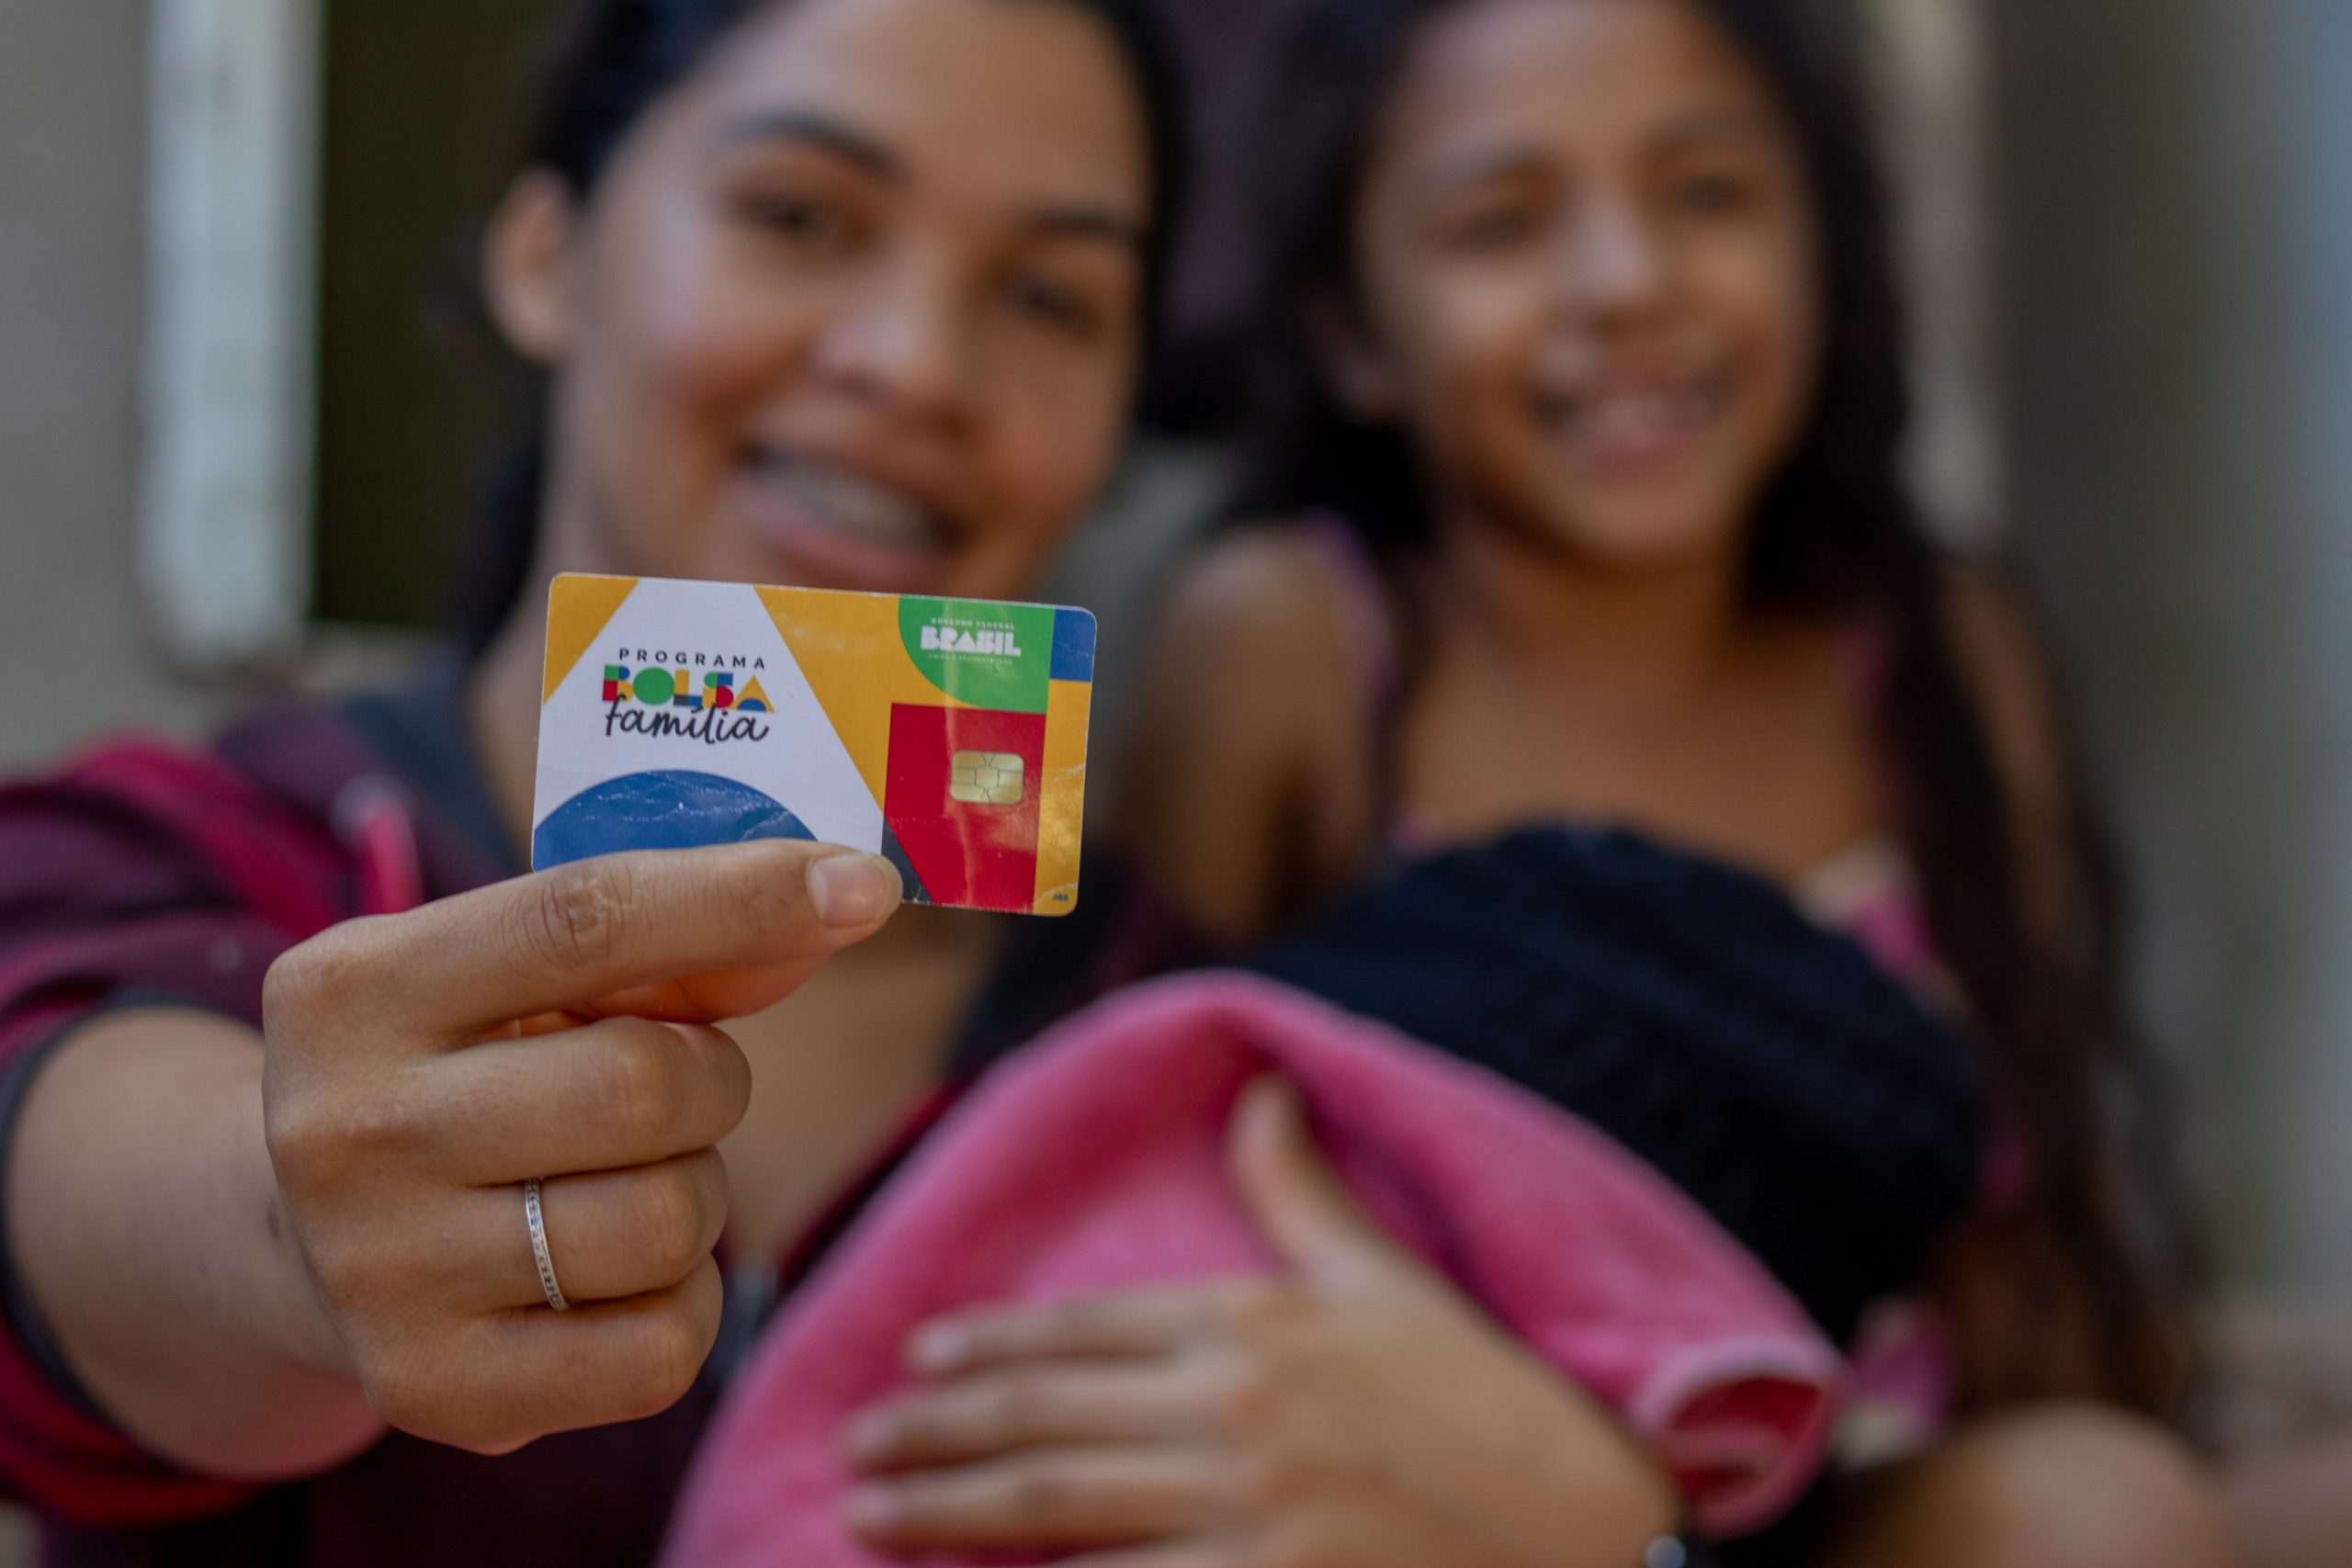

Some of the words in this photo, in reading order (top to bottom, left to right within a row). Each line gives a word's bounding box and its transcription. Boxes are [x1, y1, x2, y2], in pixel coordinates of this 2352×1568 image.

[619, 648, 764, 669] PROGRAMA
[921, 626, 1022, 657] BRASIL
[602, 663, 775, 714] BOLSA
[605, 692, 770, 745] família
